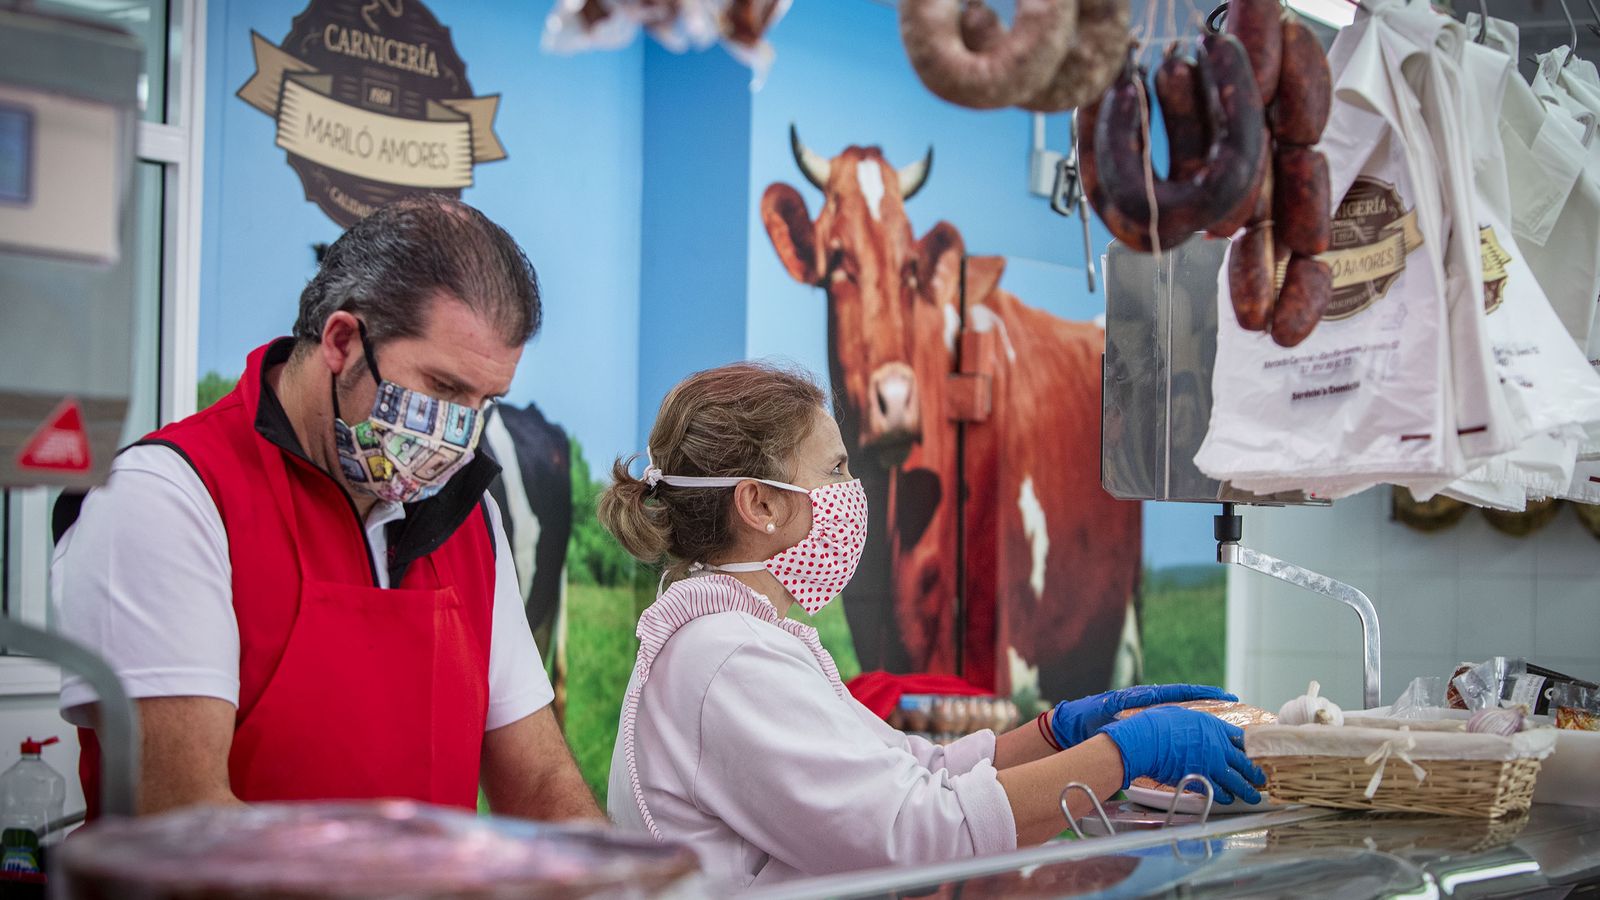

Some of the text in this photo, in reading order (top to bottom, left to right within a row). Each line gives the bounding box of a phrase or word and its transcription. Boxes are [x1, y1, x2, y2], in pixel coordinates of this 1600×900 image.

[324, 24, 439, 77] CARNICERÍA
[303, 112, 450, 170] MARILÓ AMORES
[1343, 246, 1395, 277] AMORES
